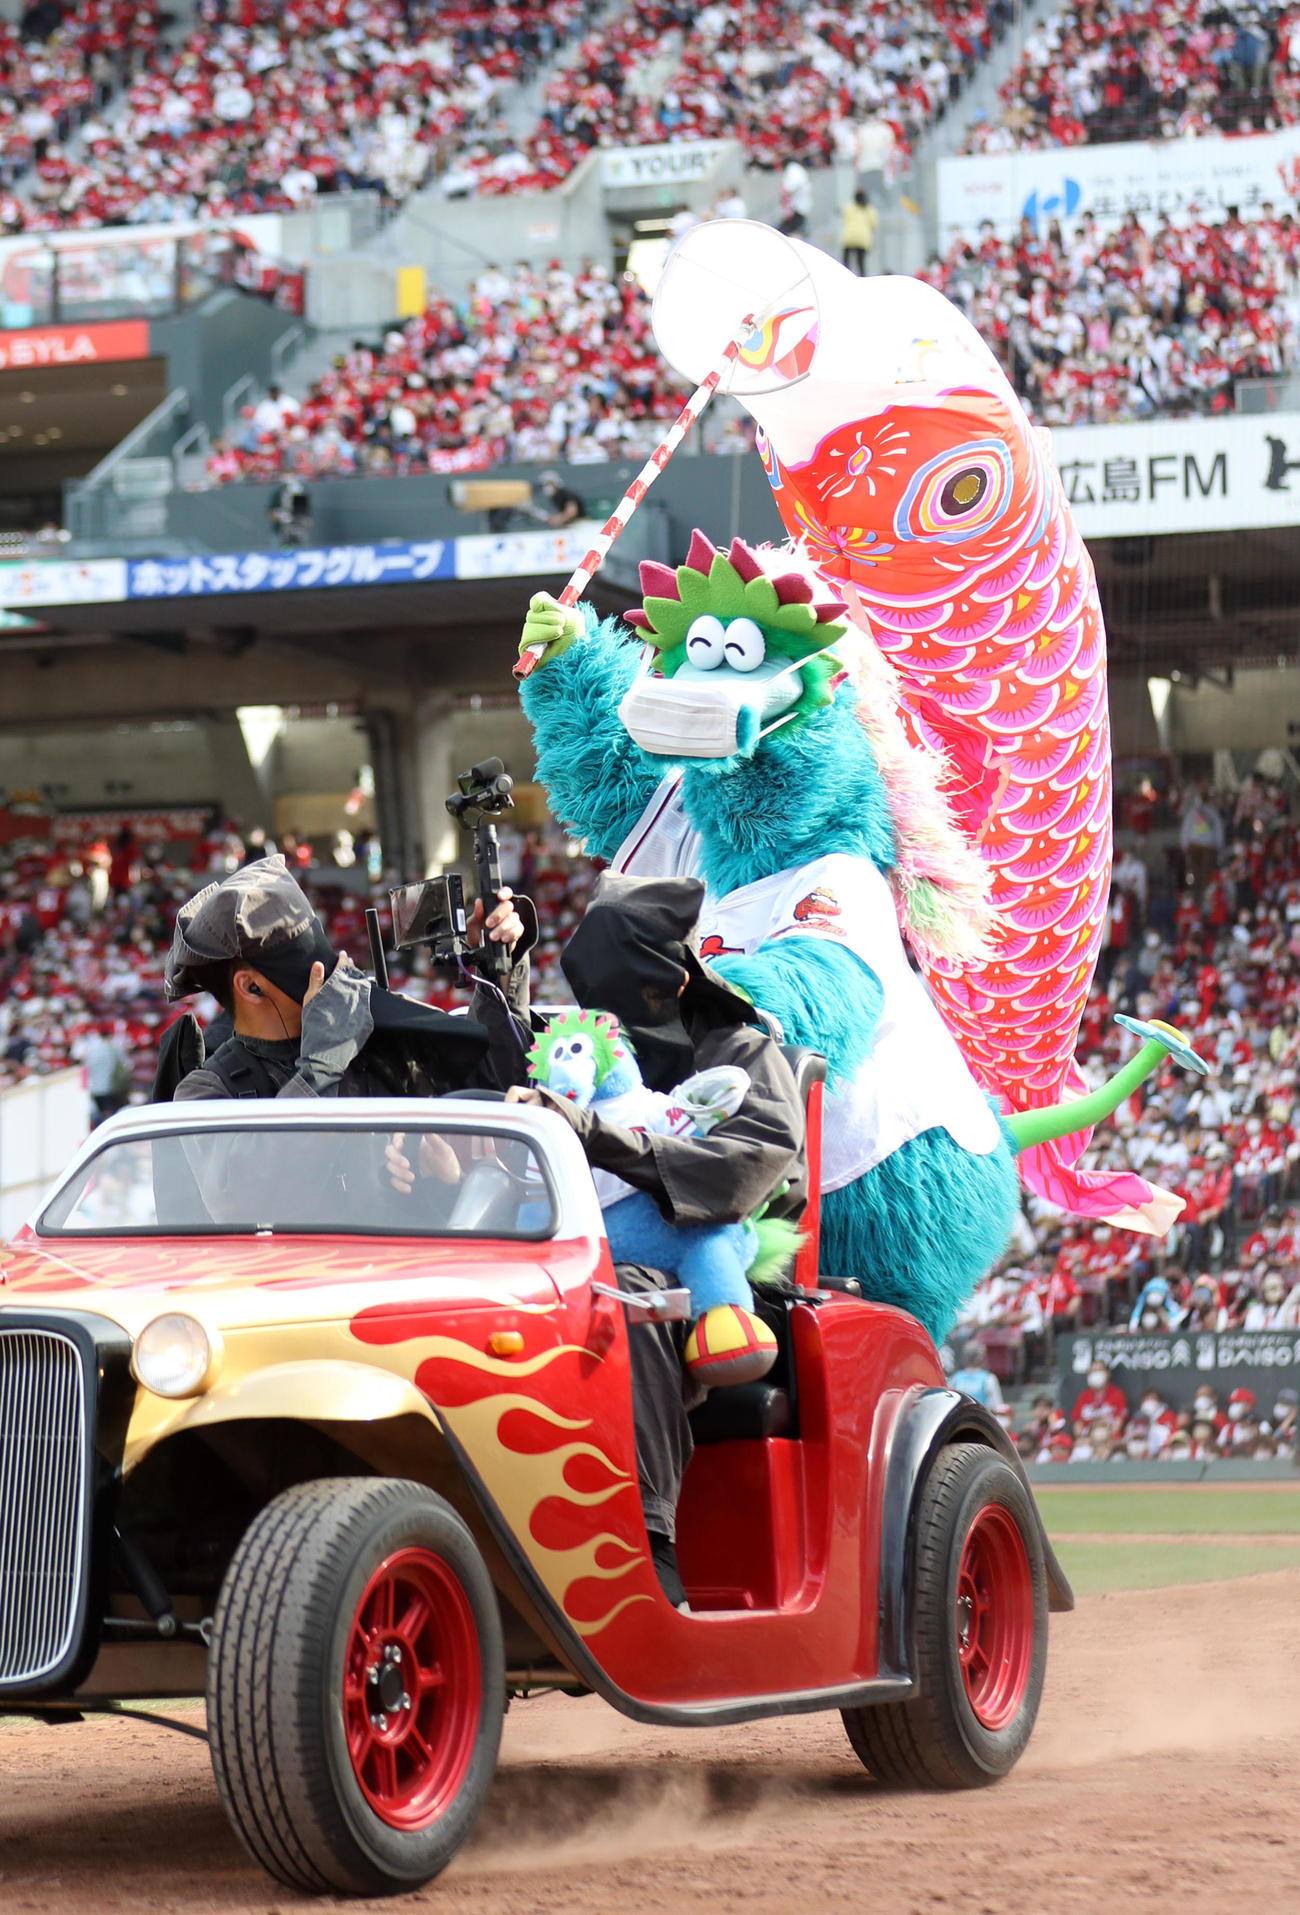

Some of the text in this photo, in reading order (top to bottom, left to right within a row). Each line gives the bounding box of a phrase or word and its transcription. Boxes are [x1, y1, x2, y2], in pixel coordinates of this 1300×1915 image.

[1060, 451, 1229, 504] 広島FM
[131, 539, 447, 596] ホットスタッフグループ
[1217, 1346, 1293, 1368] DAISO
